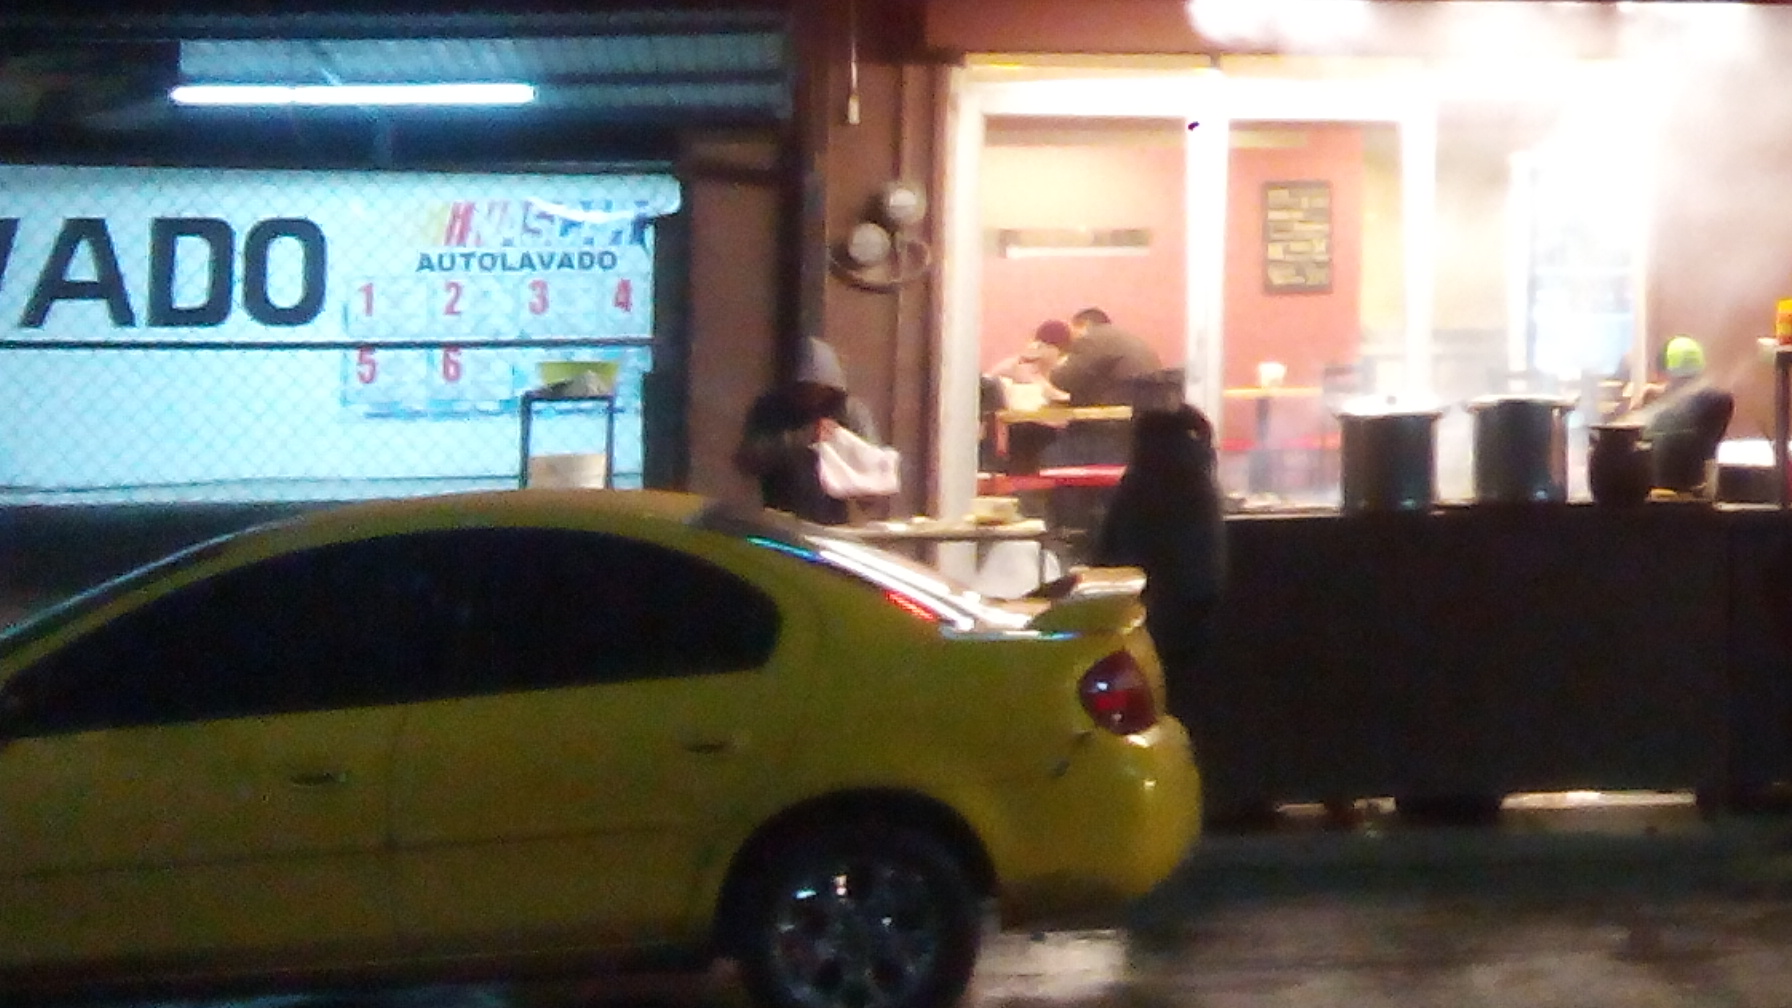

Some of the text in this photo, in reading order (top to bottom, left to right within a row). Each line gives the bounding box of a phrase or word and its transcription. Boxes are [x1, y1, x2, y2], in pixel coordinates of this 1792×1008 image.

[415, 250, 619, 273] AUTOLAVADO
[358, 277, 634, 317] 1 2 3 4
[357, 344, 462, 384] 5 6
